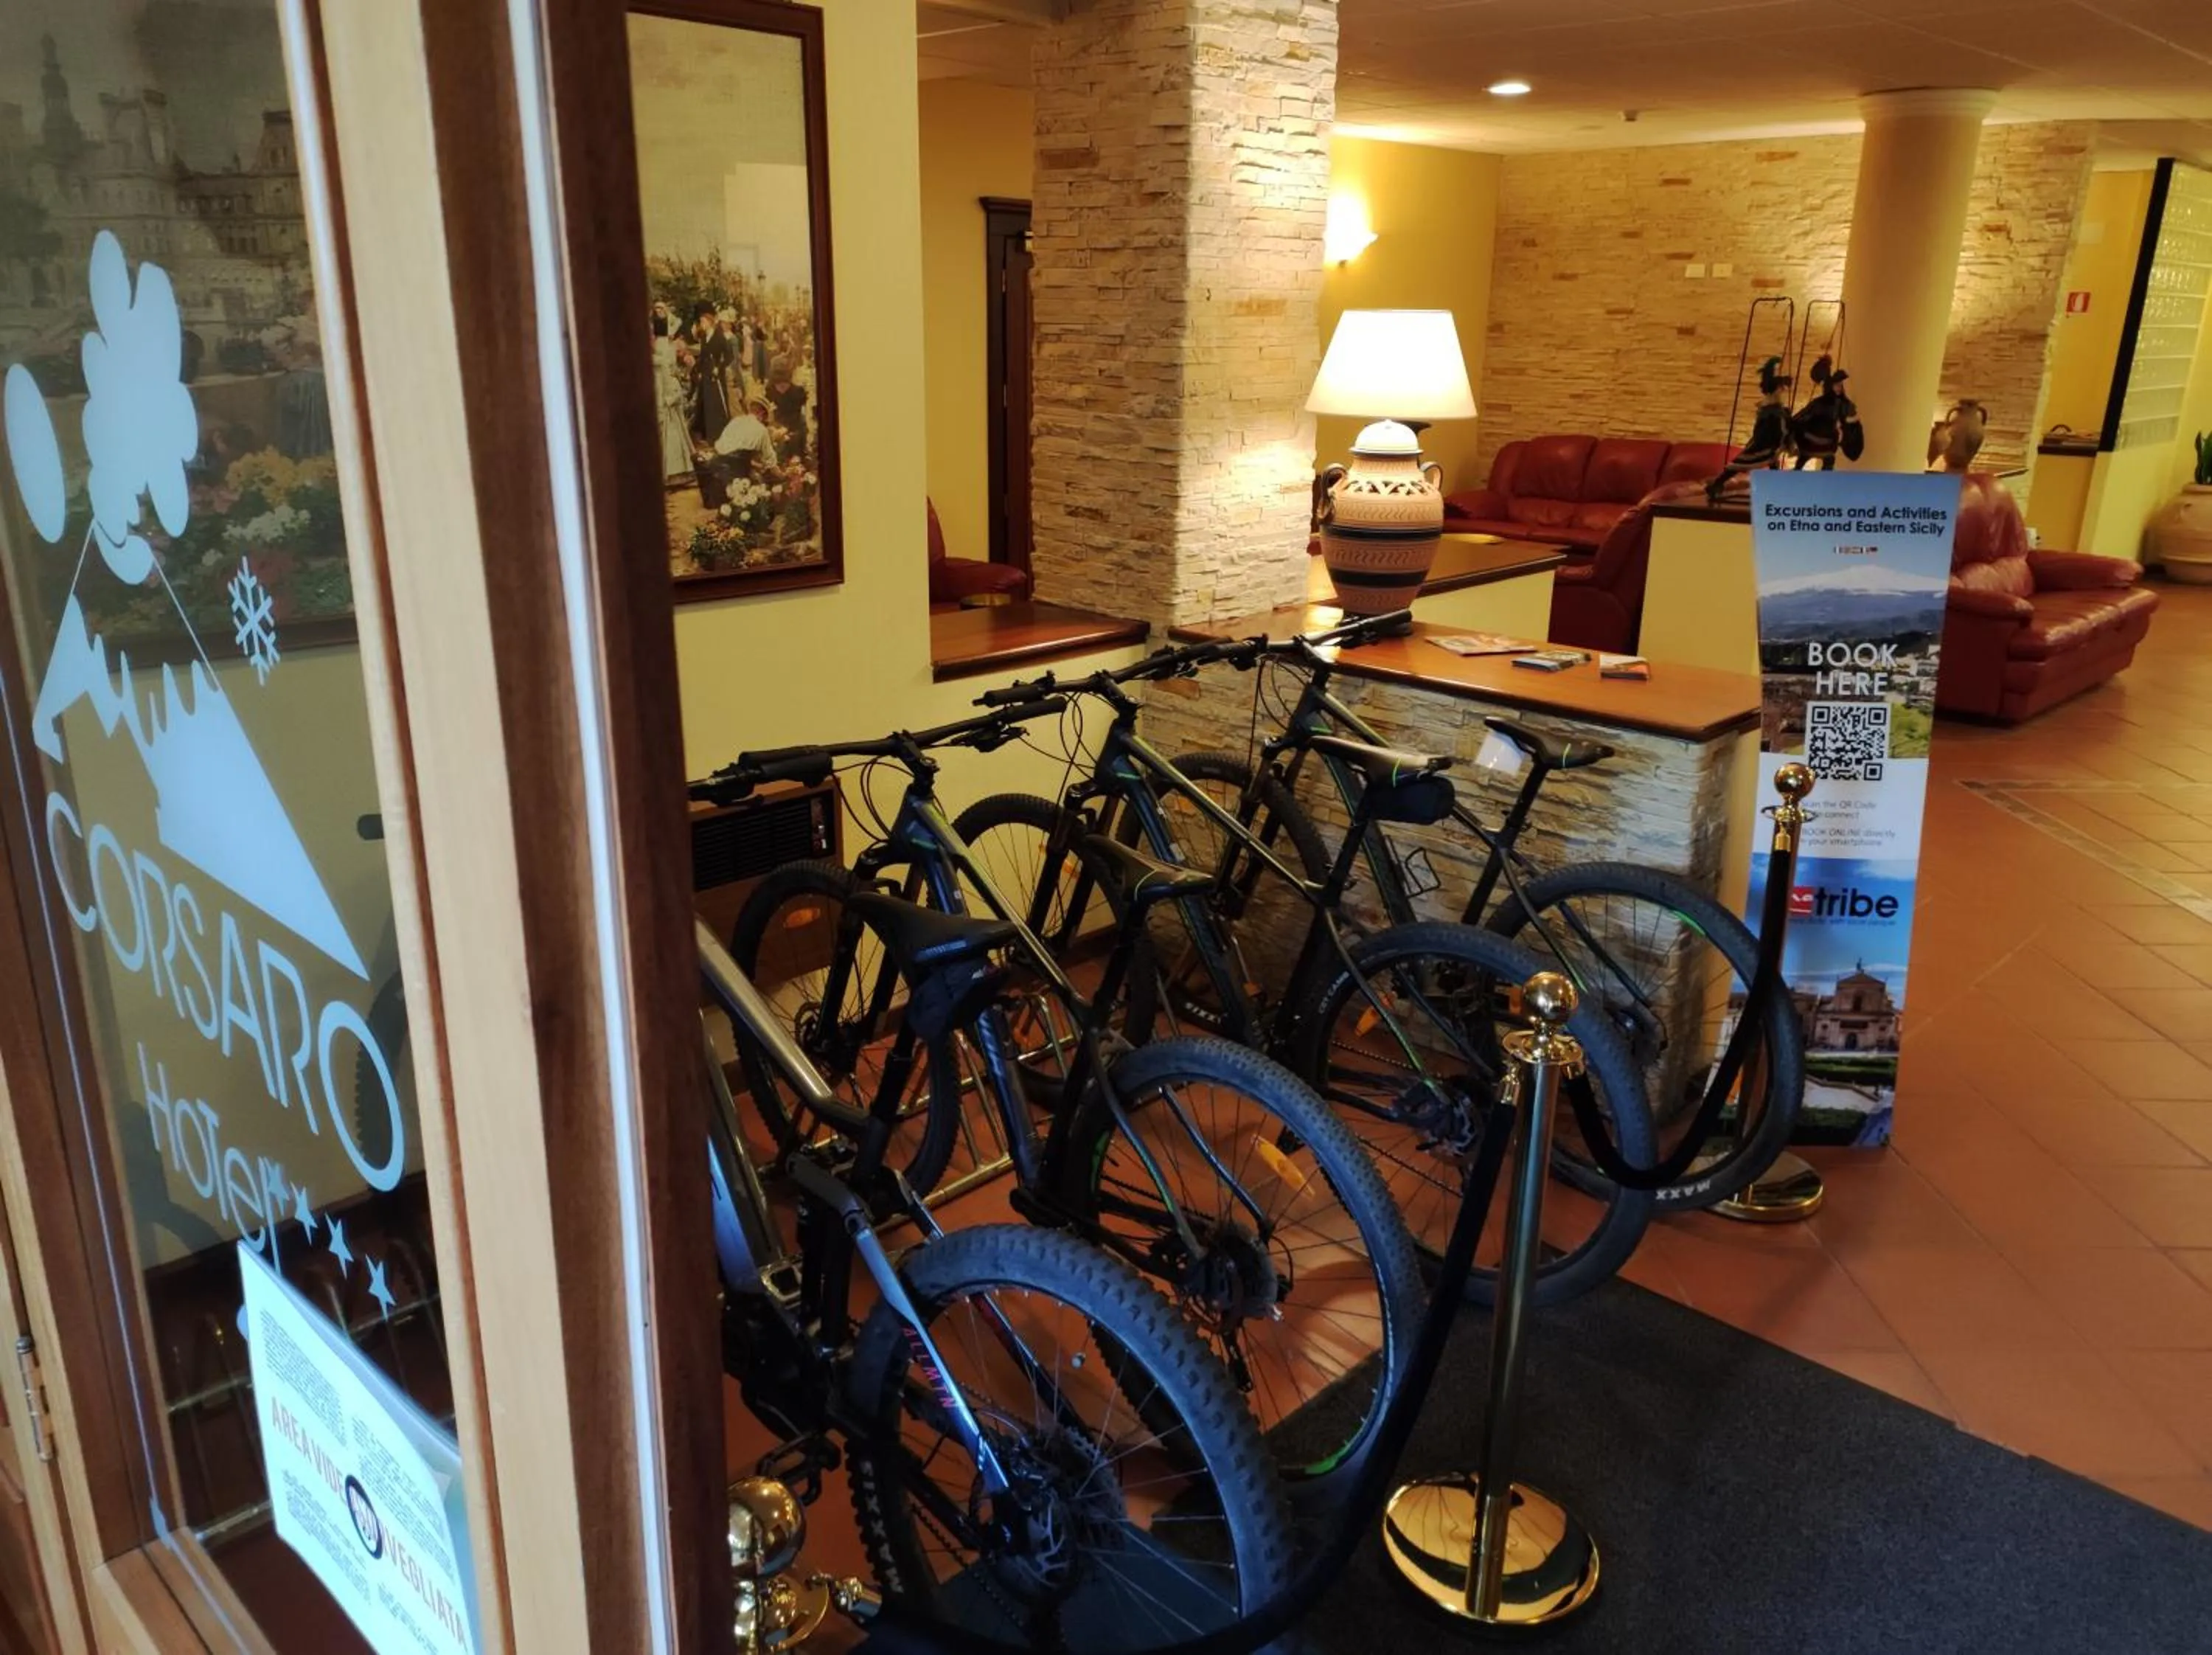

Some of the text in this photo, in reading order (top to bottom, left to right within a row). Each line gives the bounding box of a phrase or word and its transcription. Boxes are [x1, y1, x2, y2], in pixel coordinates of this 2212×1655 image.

[1765, 504, 1947, 520] Excursions and Activities
[1767, 519, 1945, 538] on Etna and Eastern Sicily
[1807, 642, 1898, 667] BOOK
[1815, 670, 1889, 696] HERE
[1815, 887, 1899, 918] tribe
[46, 791, 405, 1192] CORSARO
[1656, 1179, 1711, 1201] MAXX
[858, 1460, 905, 1595] MAXXIS
